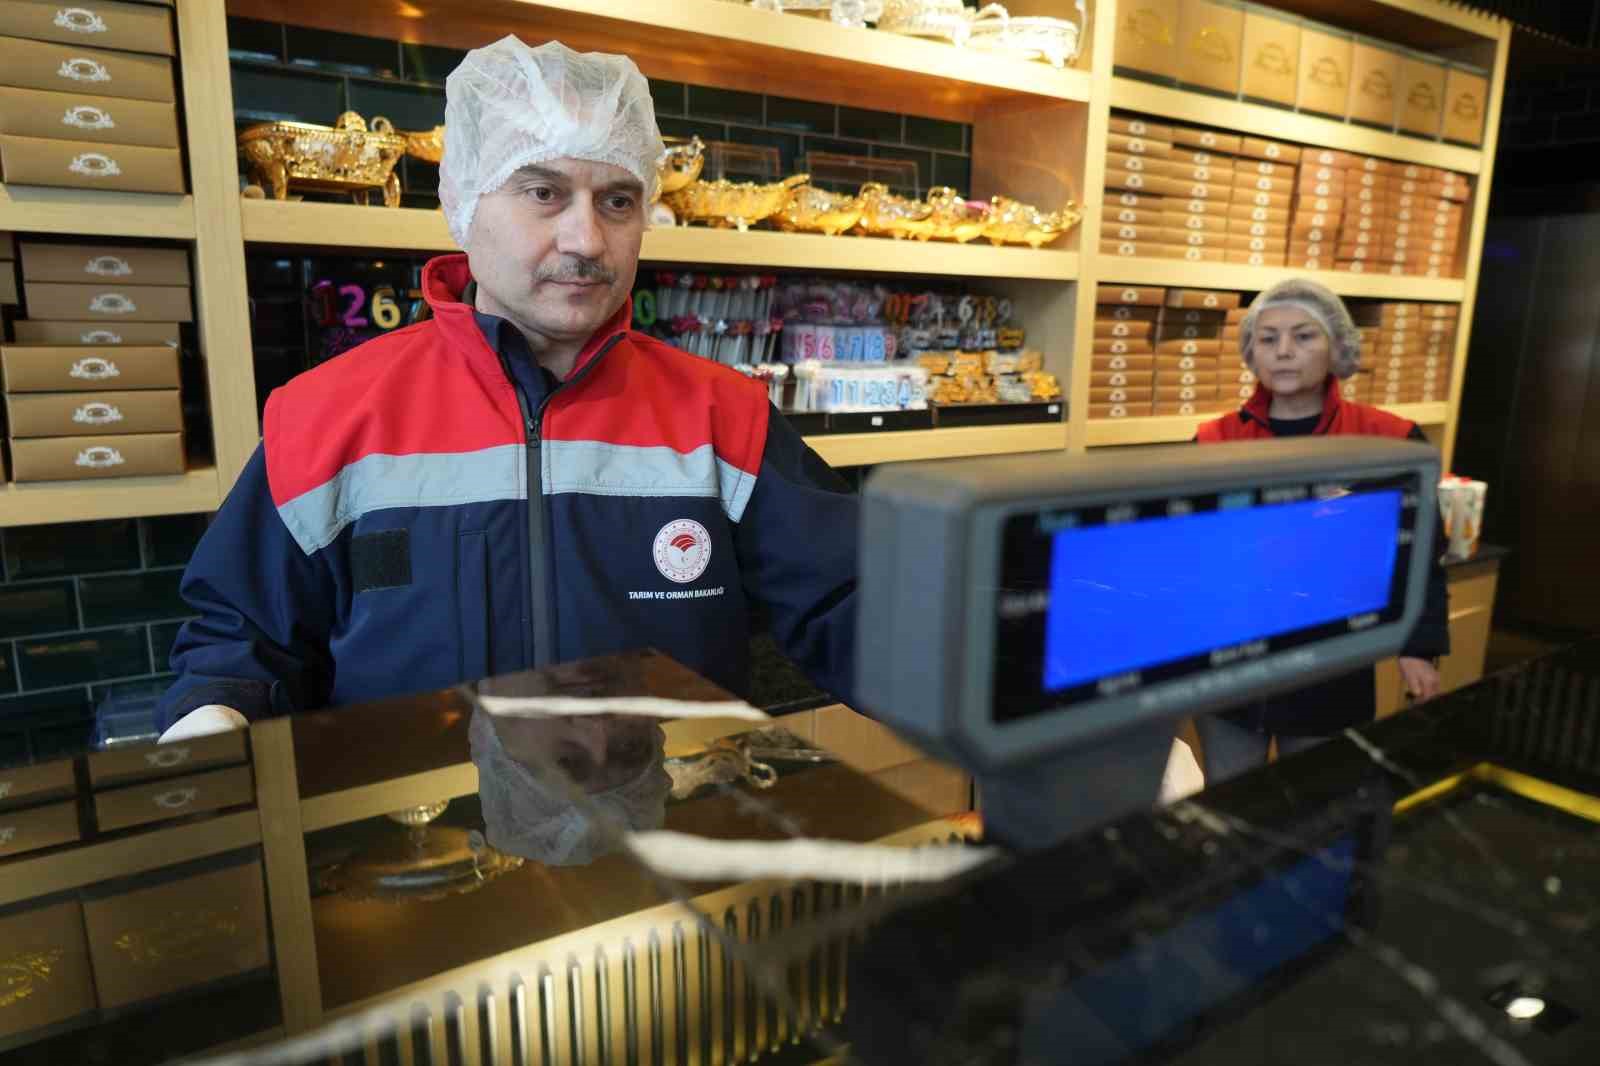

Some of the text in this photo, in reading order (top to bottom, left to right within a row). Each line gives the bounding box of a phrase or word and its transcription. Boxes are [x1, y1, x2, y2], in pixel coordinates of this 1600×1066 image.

[338, 284, 368, 328] 2
[371, 286, 401, 330] 6
[628, 591, 654, 600] TARIM
[654, 591, 665, 600] VE
[665, 590, 694, 600] ORMAN
